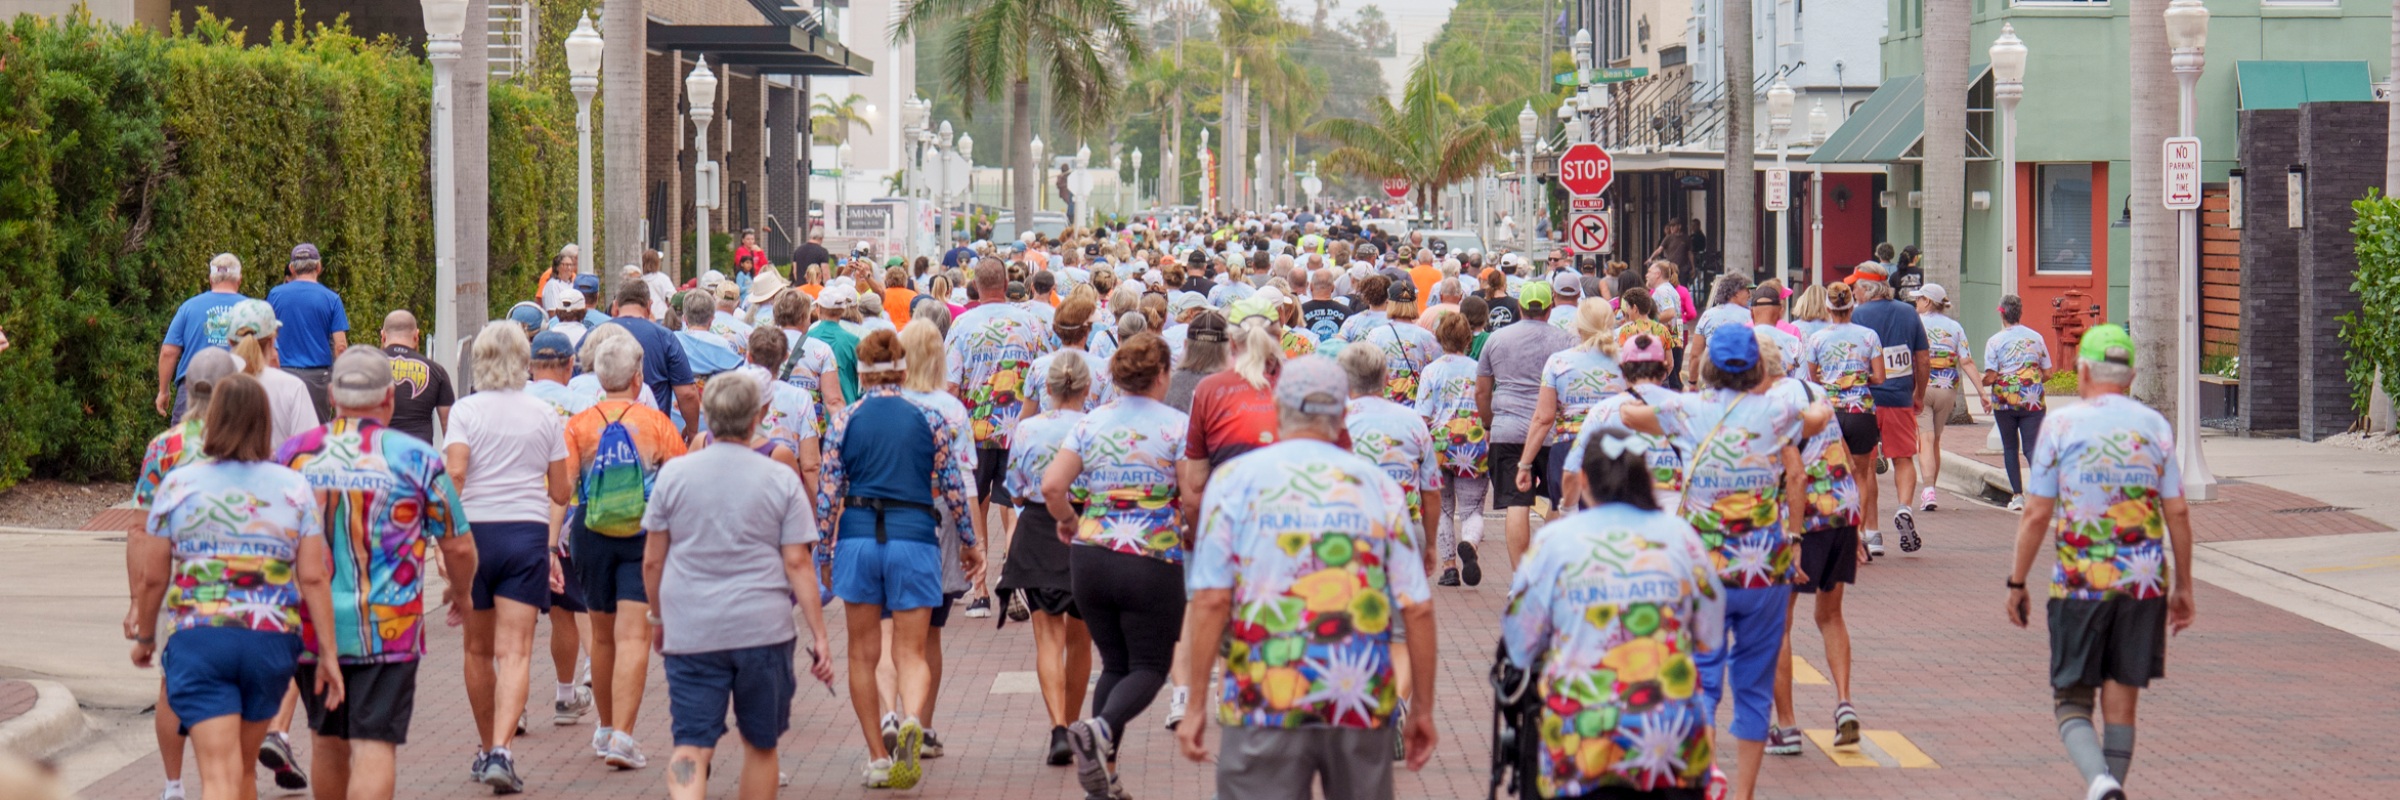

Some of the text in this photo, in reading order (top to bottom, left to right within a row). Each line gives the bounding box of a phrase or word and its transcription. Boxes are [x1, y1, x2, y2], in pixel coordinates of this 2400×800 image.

[1625, 69, 1635, 77] St.
[2176, 147, 2188, 159] NO
[1564, 160, 1608, 180] STOP
[2170, 162, 2195, 170] PARKING
[1385, 178, 1408, 190] STOP
[2176, 183, 2188, 191] TIME
[847, 208, 890, 218] UMINARY
[1305, 309, 1345, 321] BLUE DOG
[972, 353, 993, 363] RUN
[1002, 350, 1028, 360] ARTS
[1888, 352, 1910, 368] 140
[1655, 455, 1680, 467] ART
[1121, 470, 1165, 482] ARTS
[1388, 469, 1412, 480] RTS
[2080, 473, 2110, 484] RUN
[2124, 472, 2156, 486] ARTS
[306, 474, 335, 486] RUN
[351, 476, 393, 489] ARTS
[1735, 475, 1774, 488] ARTS
[1260, 514, 1302, 529] RUN
[180, 540, 218, 553] RUN
[240, 542, 291, 557] ARTS
[1568, 586, 1607, 602] RUN
[1629, 580, 1679, 598] ARTS
